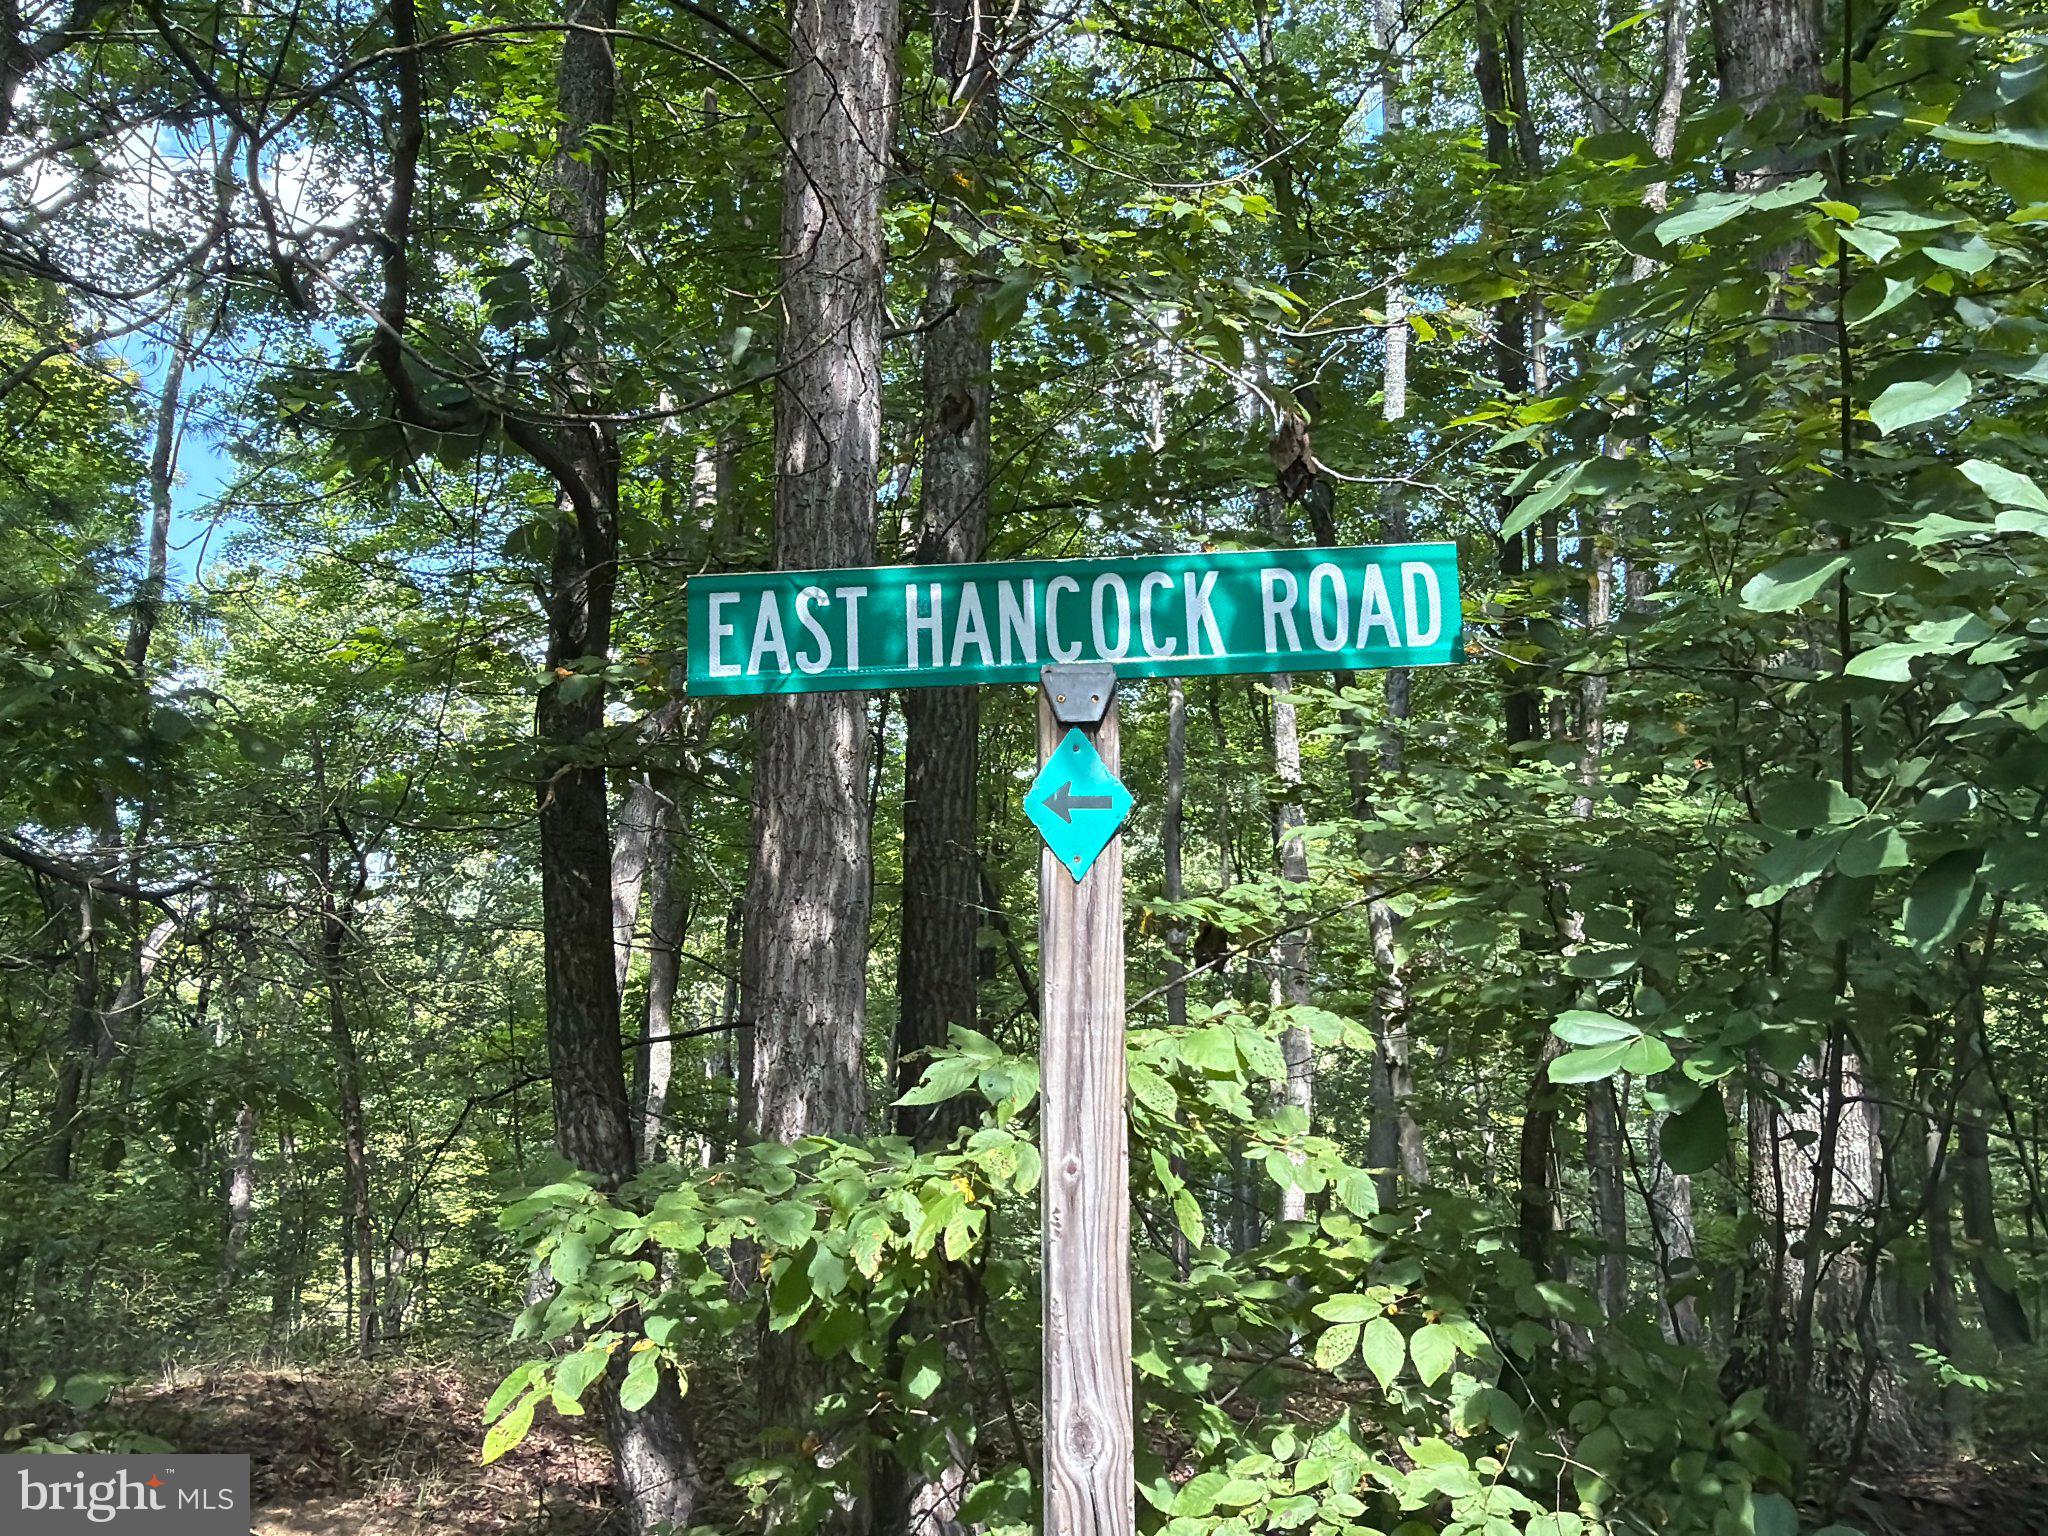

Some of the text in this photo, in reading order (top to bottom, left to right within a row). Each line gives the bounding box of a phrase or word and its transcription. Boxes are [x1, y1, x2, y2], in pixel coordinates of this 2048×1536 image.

[708, 561, 1441, 678] EAST HANCOCK ROAD
